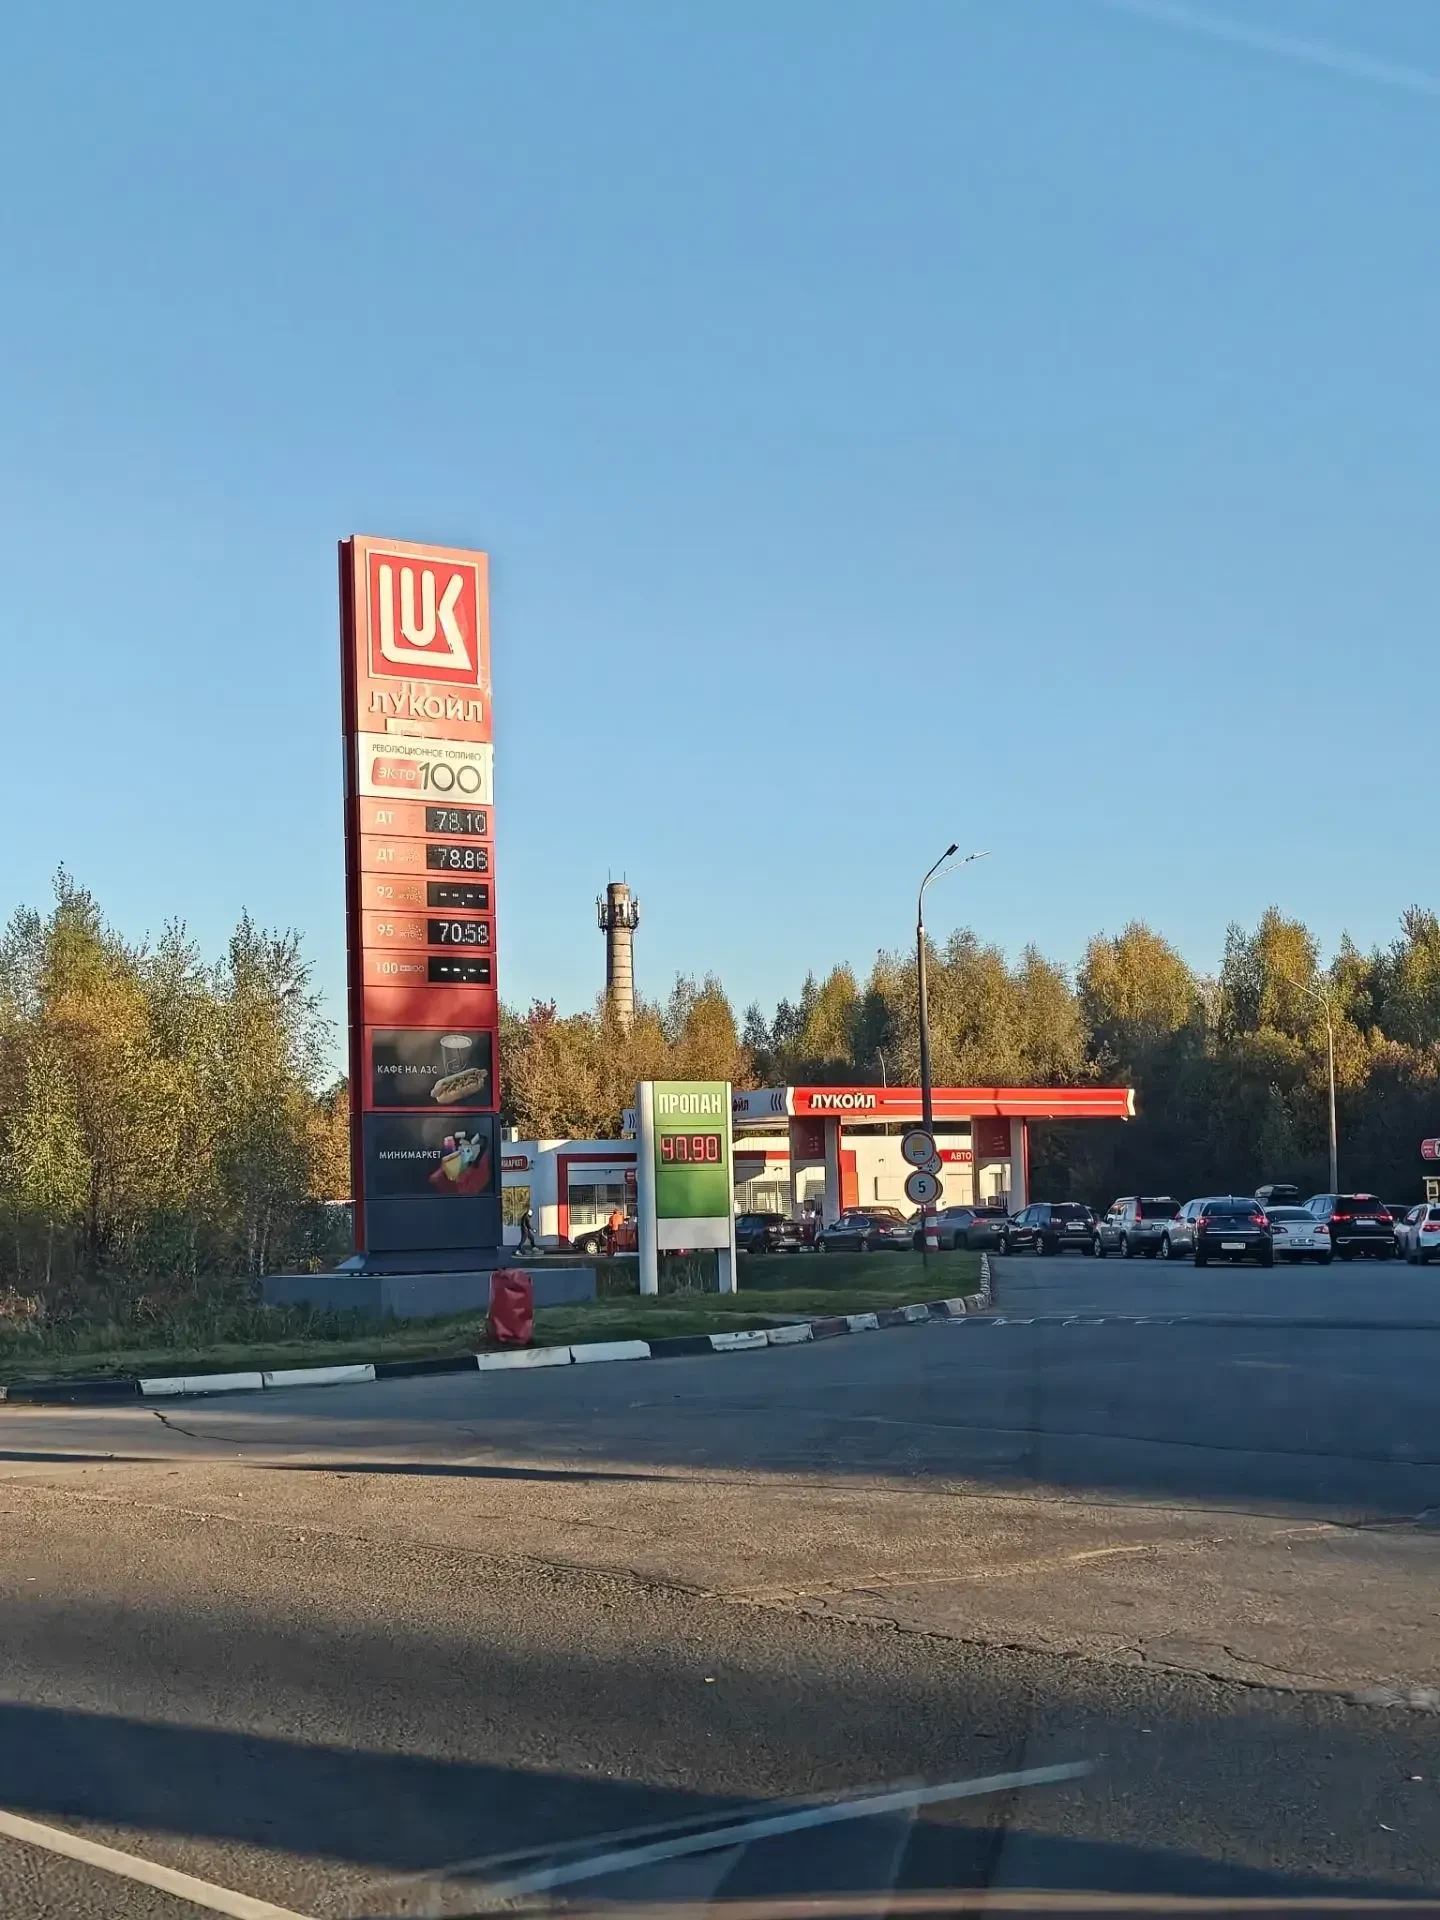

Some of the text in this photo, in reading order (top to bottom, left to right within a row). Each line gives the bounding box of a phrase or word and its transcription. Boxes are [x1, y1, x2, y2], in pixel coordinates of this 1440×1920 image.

[369, 691, 483, 722] ЛУКОЙЛ
[372, 743, 482, 761] РЕВОЛЮЦИОННОЕ ТОПЛИВО
[419, 762, 482, 794] 100
[374, 810, 486, 833] ДТ 78.10
[375, 848, 395, 863] ДТ
[437, 847, 488, 870] 78.86
[376, 885, 394, 899] 92
[376, 923, 394, 936] 95
[439, 922, 489, 944] 70.58
[375, 961, 398, 974] 100
[377, 1064, 438, 1075] КАФЕ НА АЗС
[658, 1093, 722, 1114] ПРОПАН
[810, 1093, 876, 1109] ЛУКОЙЛ
[379, 1150, 441, 1159] МИНИМАРКЕТ
[661, 1136, 718, 1161] 47.90
[918, 1180, 926, 1194] 5
